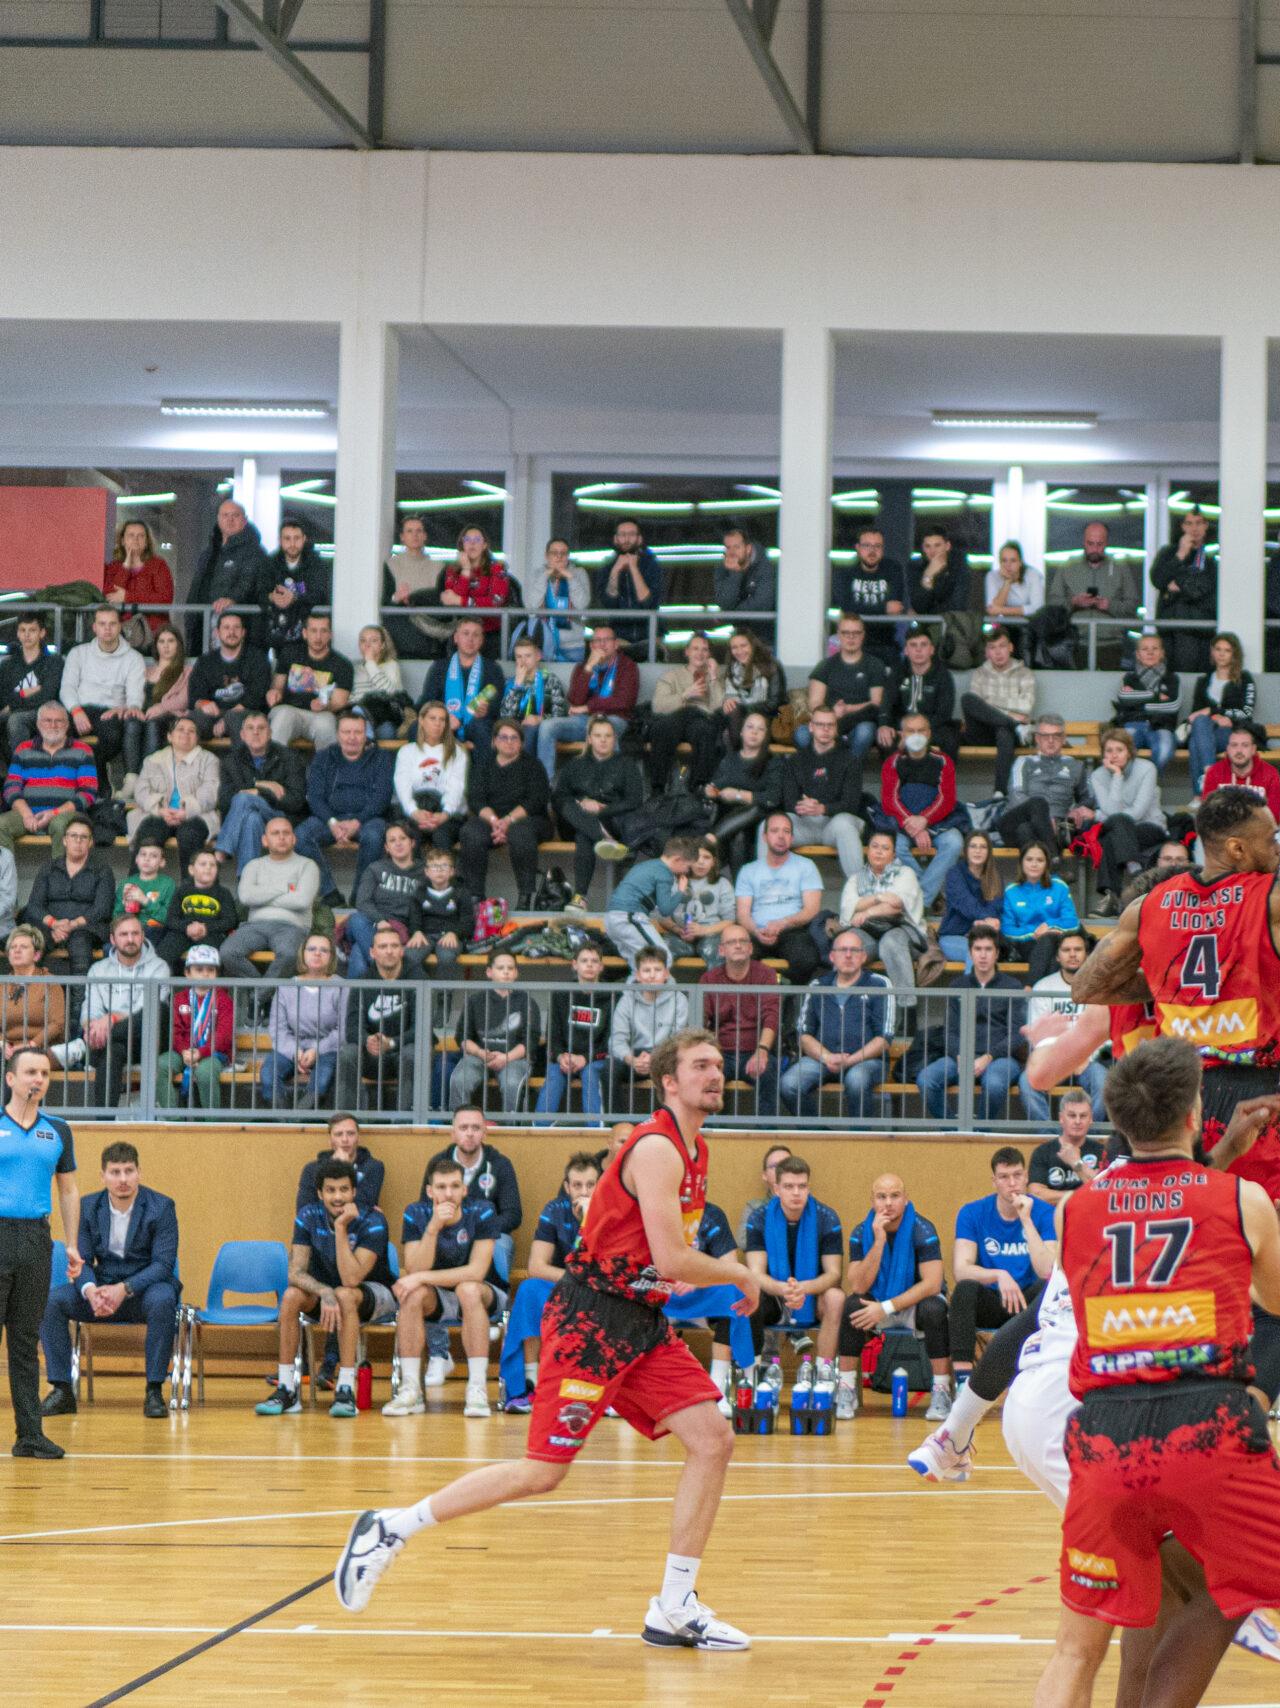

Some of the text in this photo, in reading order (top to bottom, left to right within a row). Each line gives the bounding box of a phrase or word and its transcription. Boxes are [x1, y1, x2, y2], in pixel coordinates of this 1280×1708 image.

[852, 578, 888, 593] NEVER
[1170, 909, 1226, 930] LIONS
[1180, 934, 1222, 998] 4
[1171, 1012, 1245, 1037] MVM
[1108, 1189, 1184, 1213] LIONS
[1001, 1242, 1029, 1256] JAK
[1103, 1217, 1193, 1288] 17
[1102, 1304, 1197, 1333] MVM
